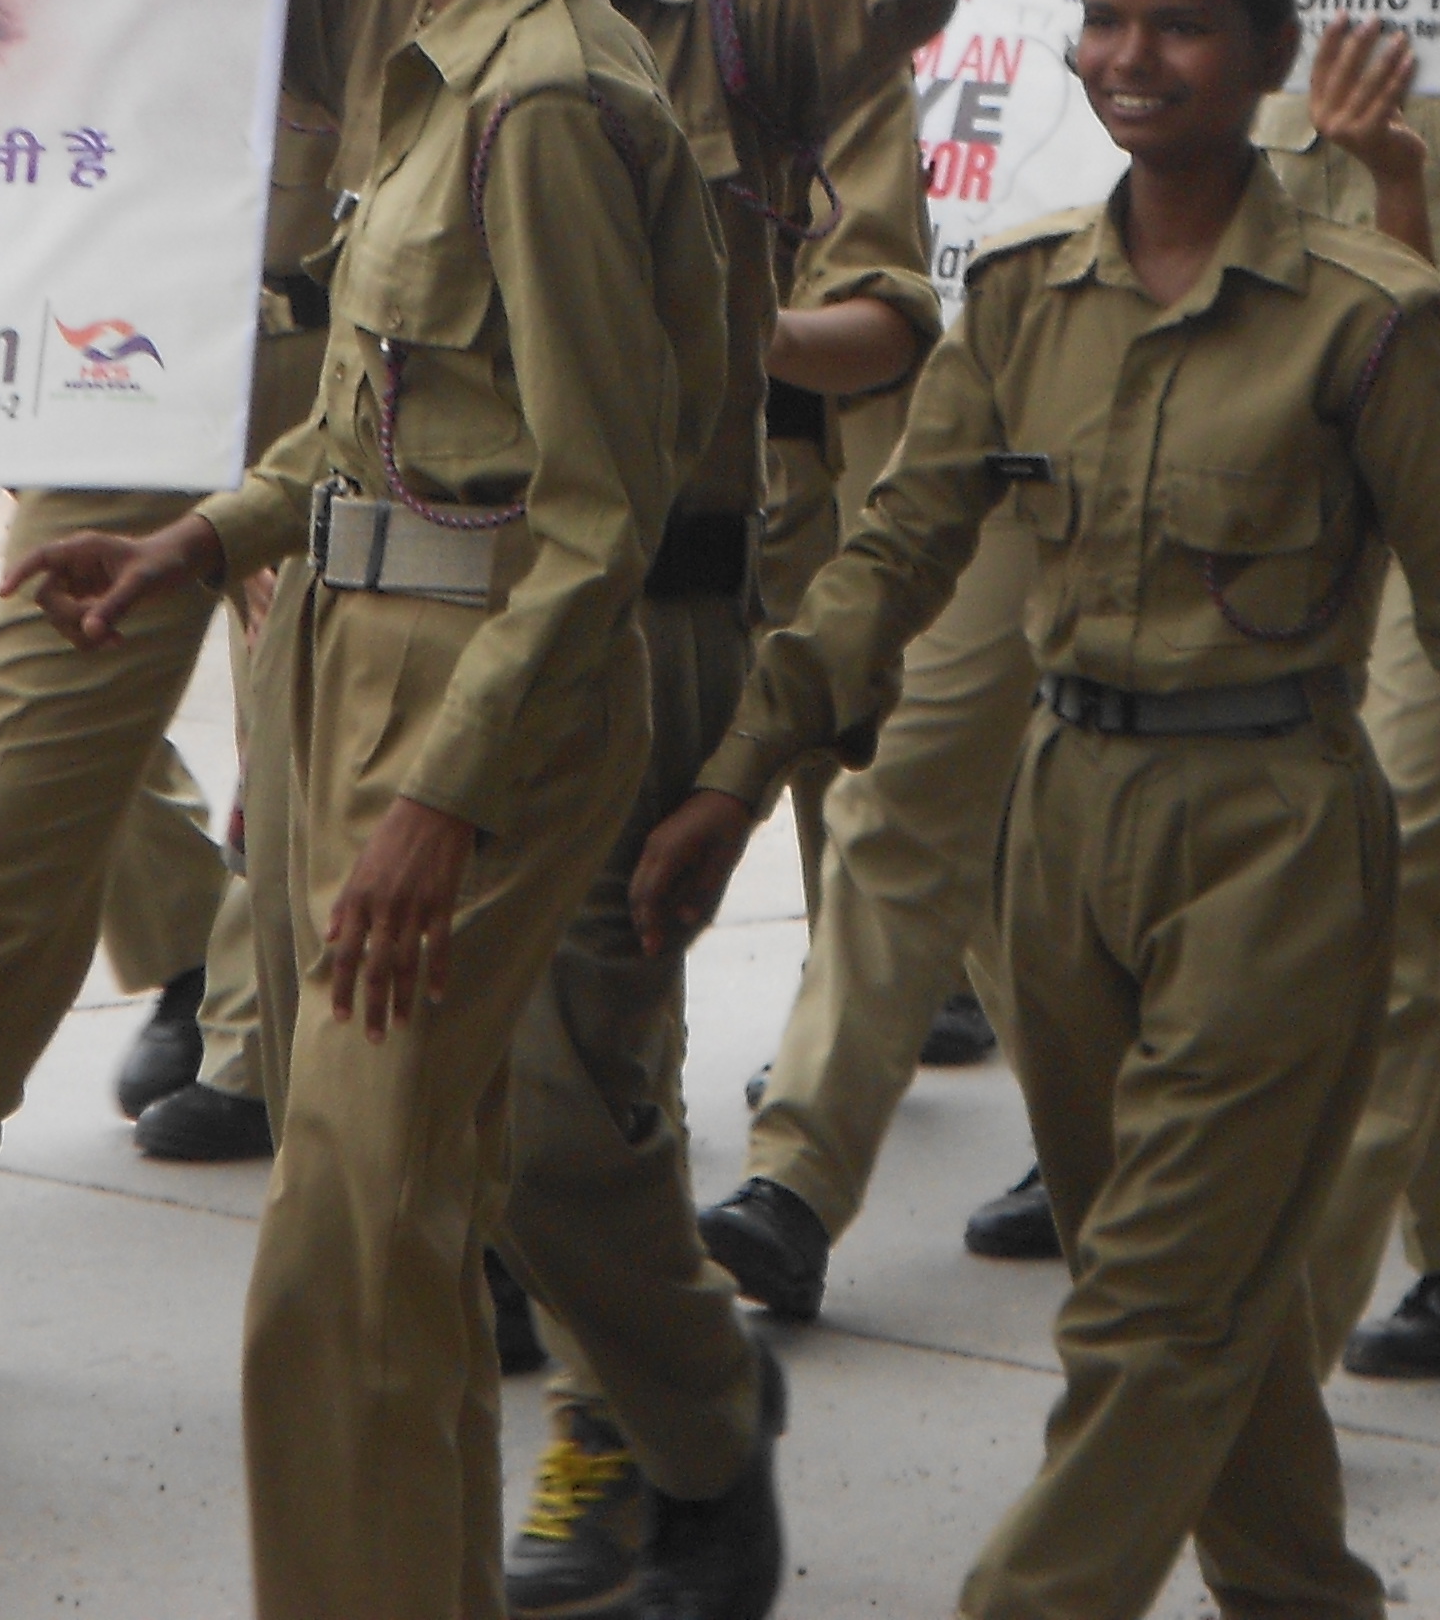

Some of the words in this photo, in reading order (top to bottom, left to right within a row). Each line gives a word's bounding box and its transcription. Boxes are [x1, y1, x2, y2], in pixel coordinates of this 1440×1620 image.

[955, 33, 1025, 86] AN
[916, 78, 1013, 145] YE
[61, 125, 116, 189] है
